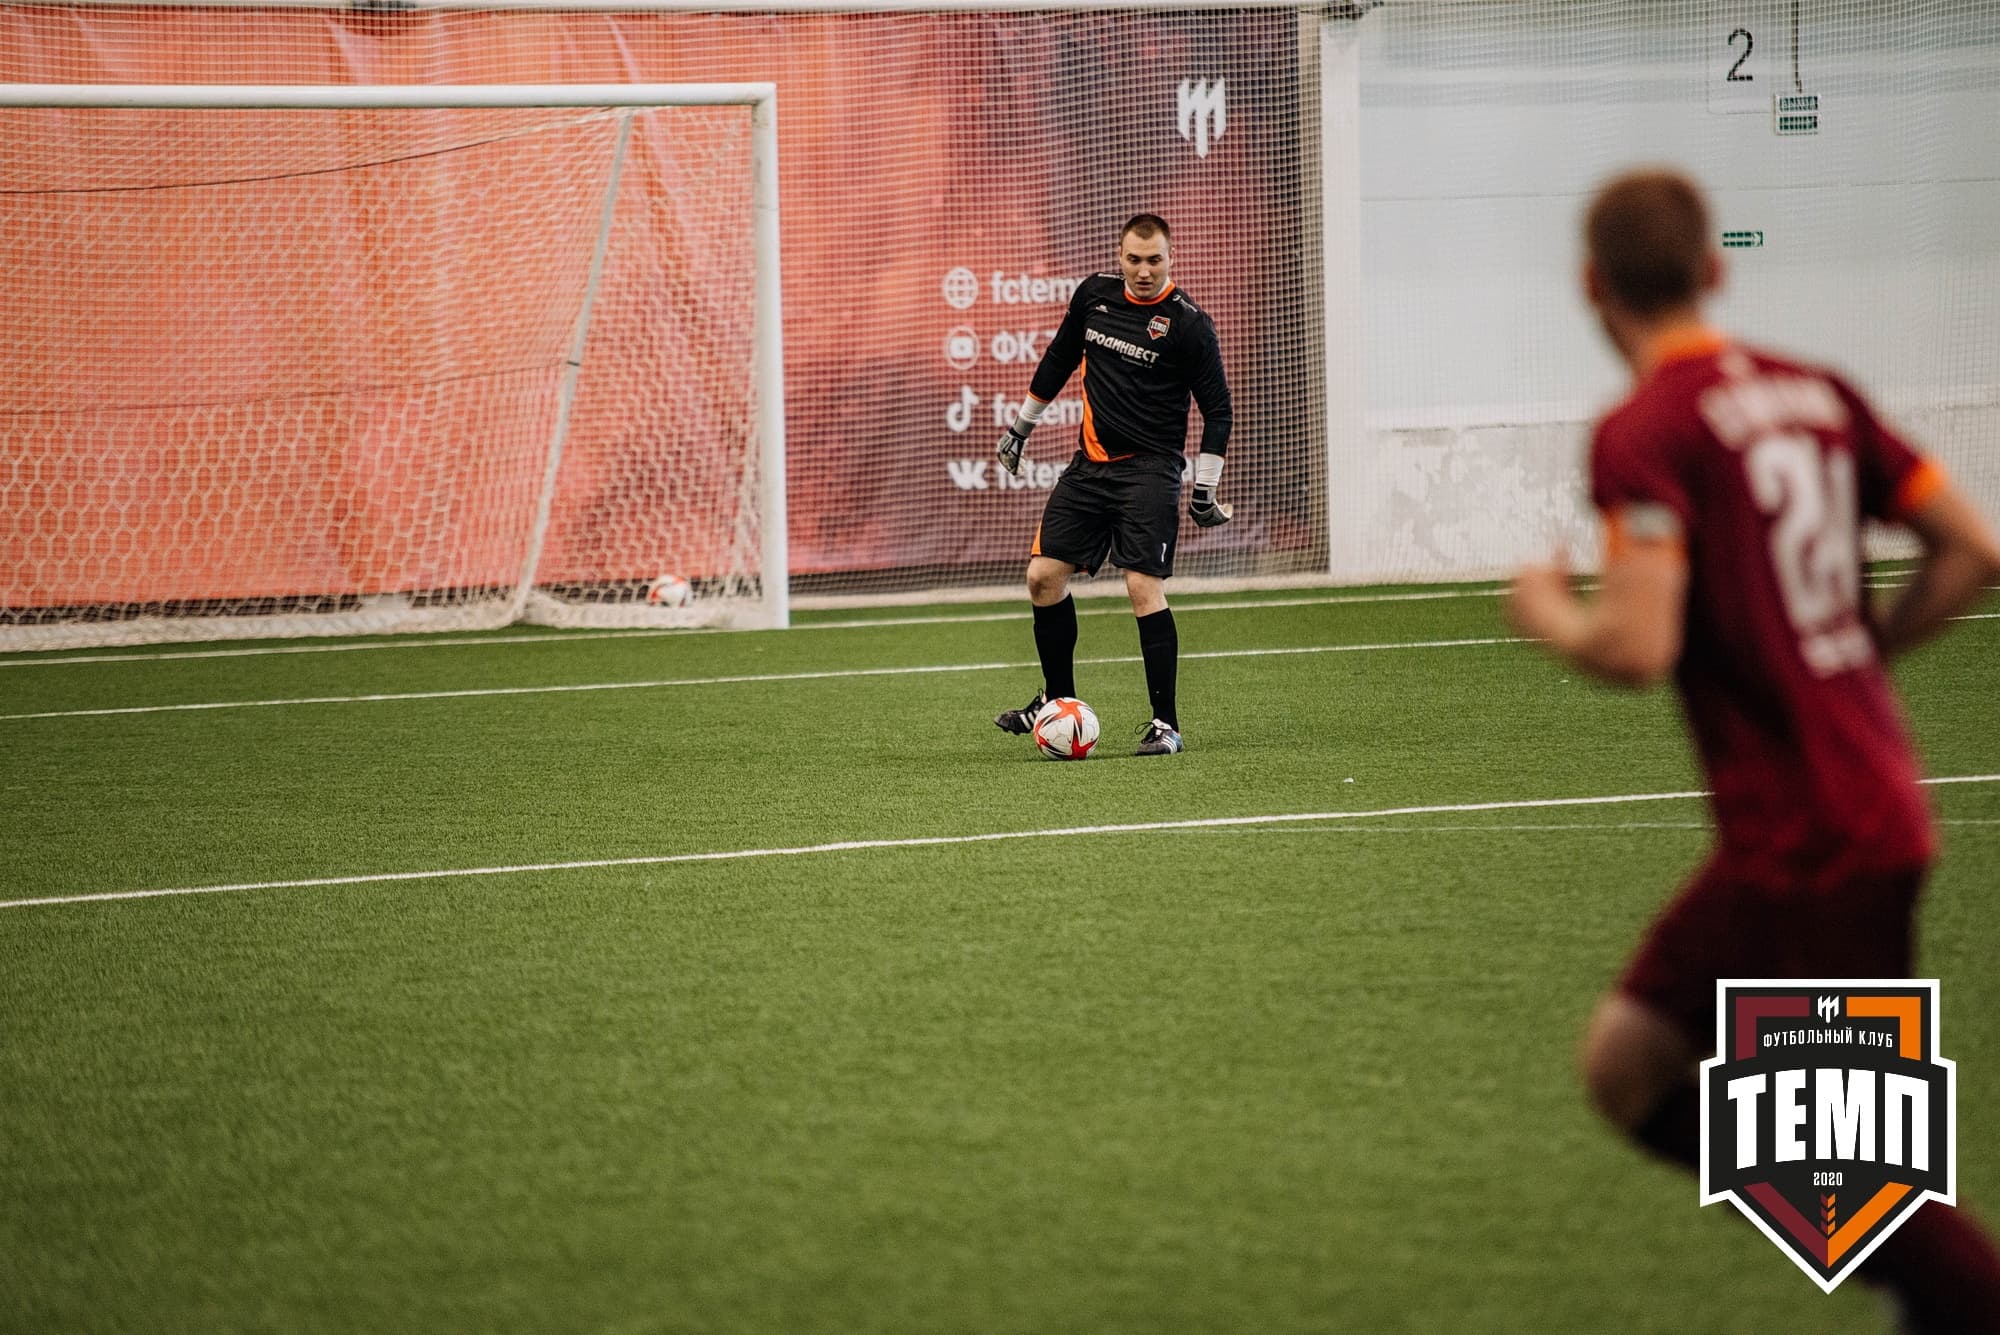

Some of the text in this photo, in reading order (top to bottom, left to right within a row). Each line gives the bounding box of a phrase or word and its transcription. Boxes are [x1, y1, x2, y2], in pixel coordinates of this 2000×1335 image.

[1726, 27, 1754, 82] 2
[1085, 327, 1160, 364] ПРОДИНВЕСТ
[1160, 542, 1168, 564] 1
